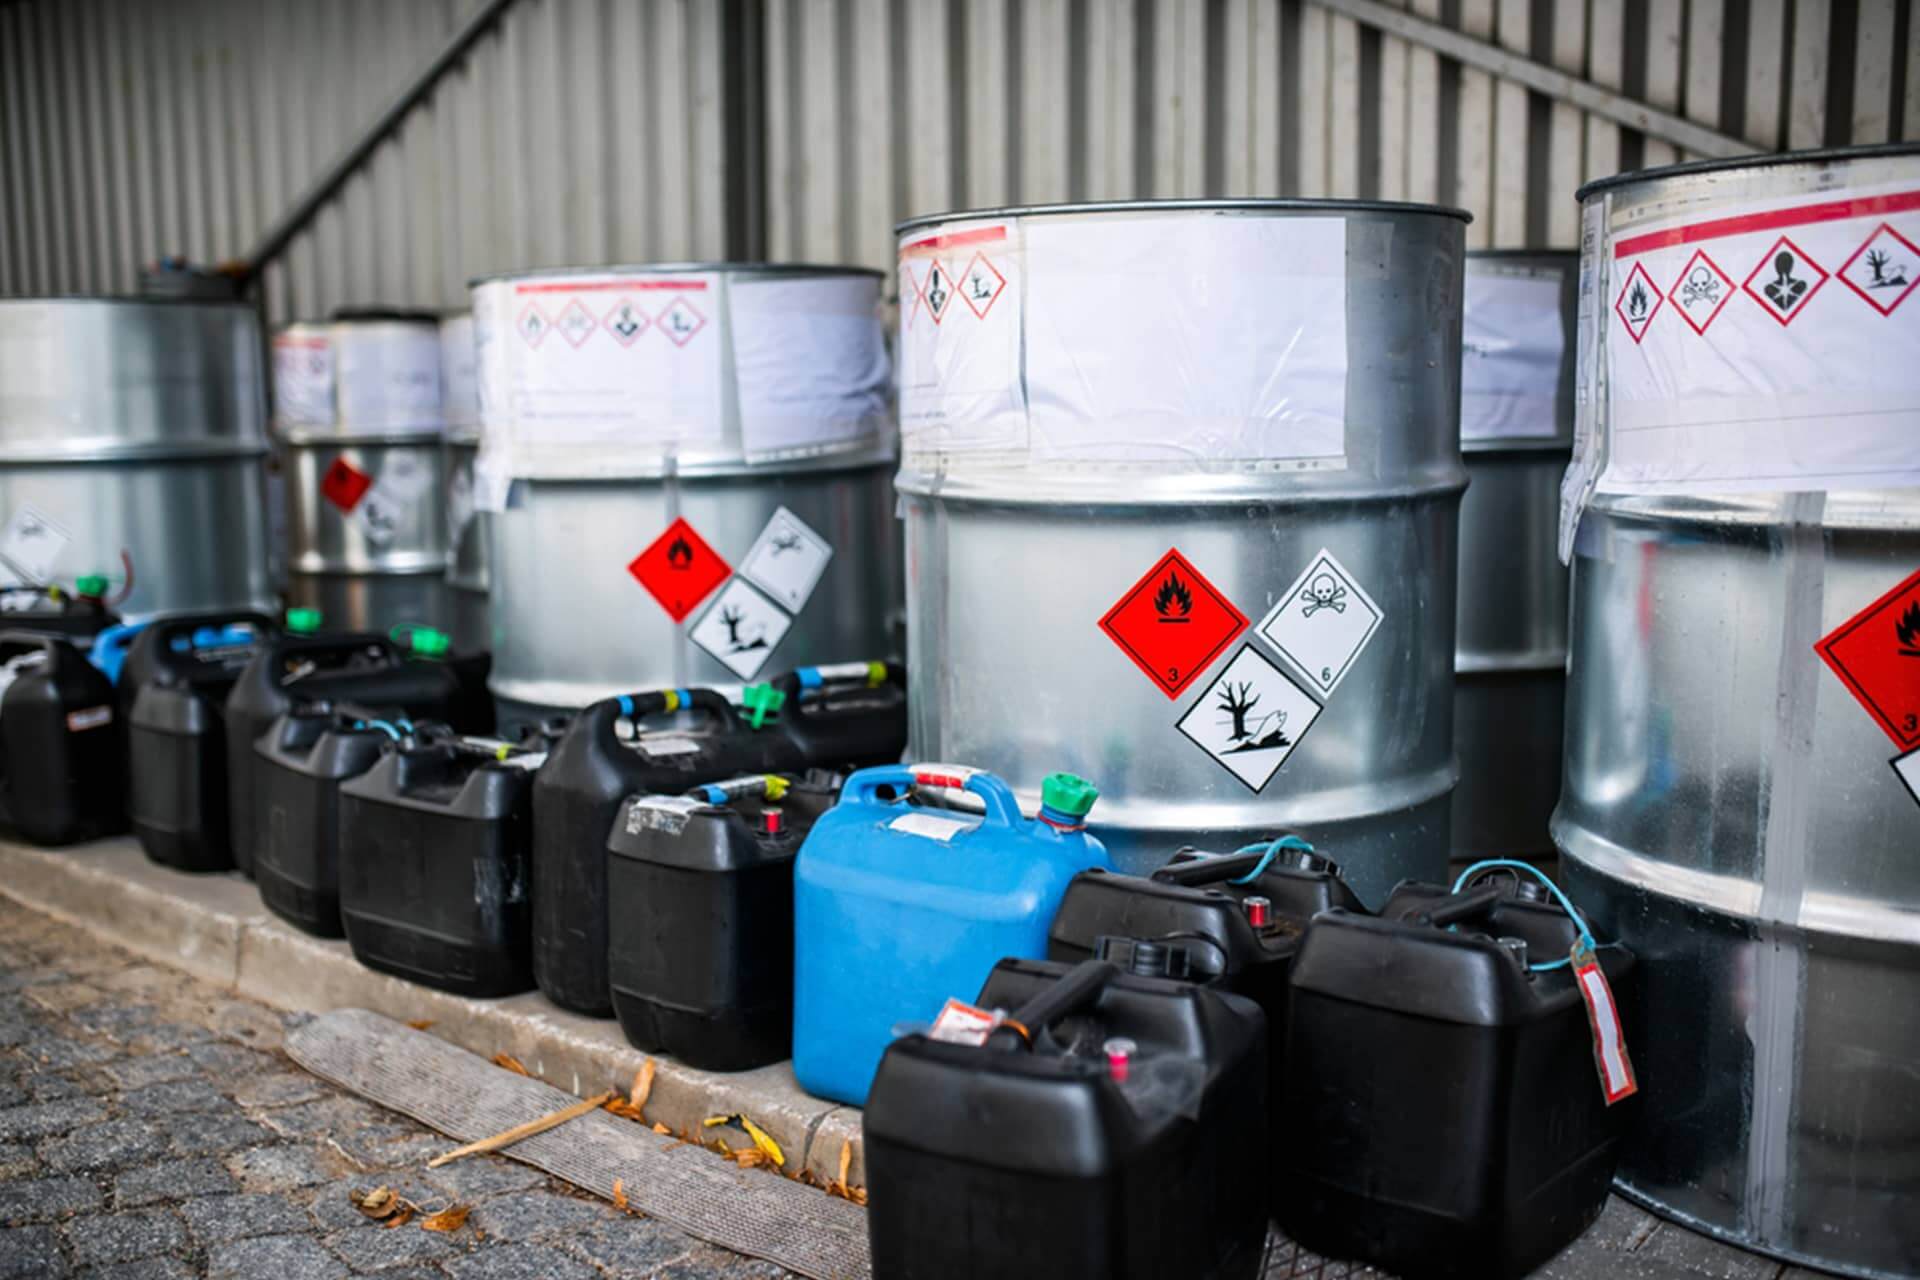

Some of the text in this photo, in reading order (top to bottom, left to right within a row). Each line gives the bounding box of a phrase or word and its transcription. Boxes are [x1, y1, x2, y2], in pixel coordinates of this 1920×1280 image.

[1168, 667, 1178, 681] 3
[1322, 667, 1331, 681] 6
[1903, 714, 1917, 731] 3
